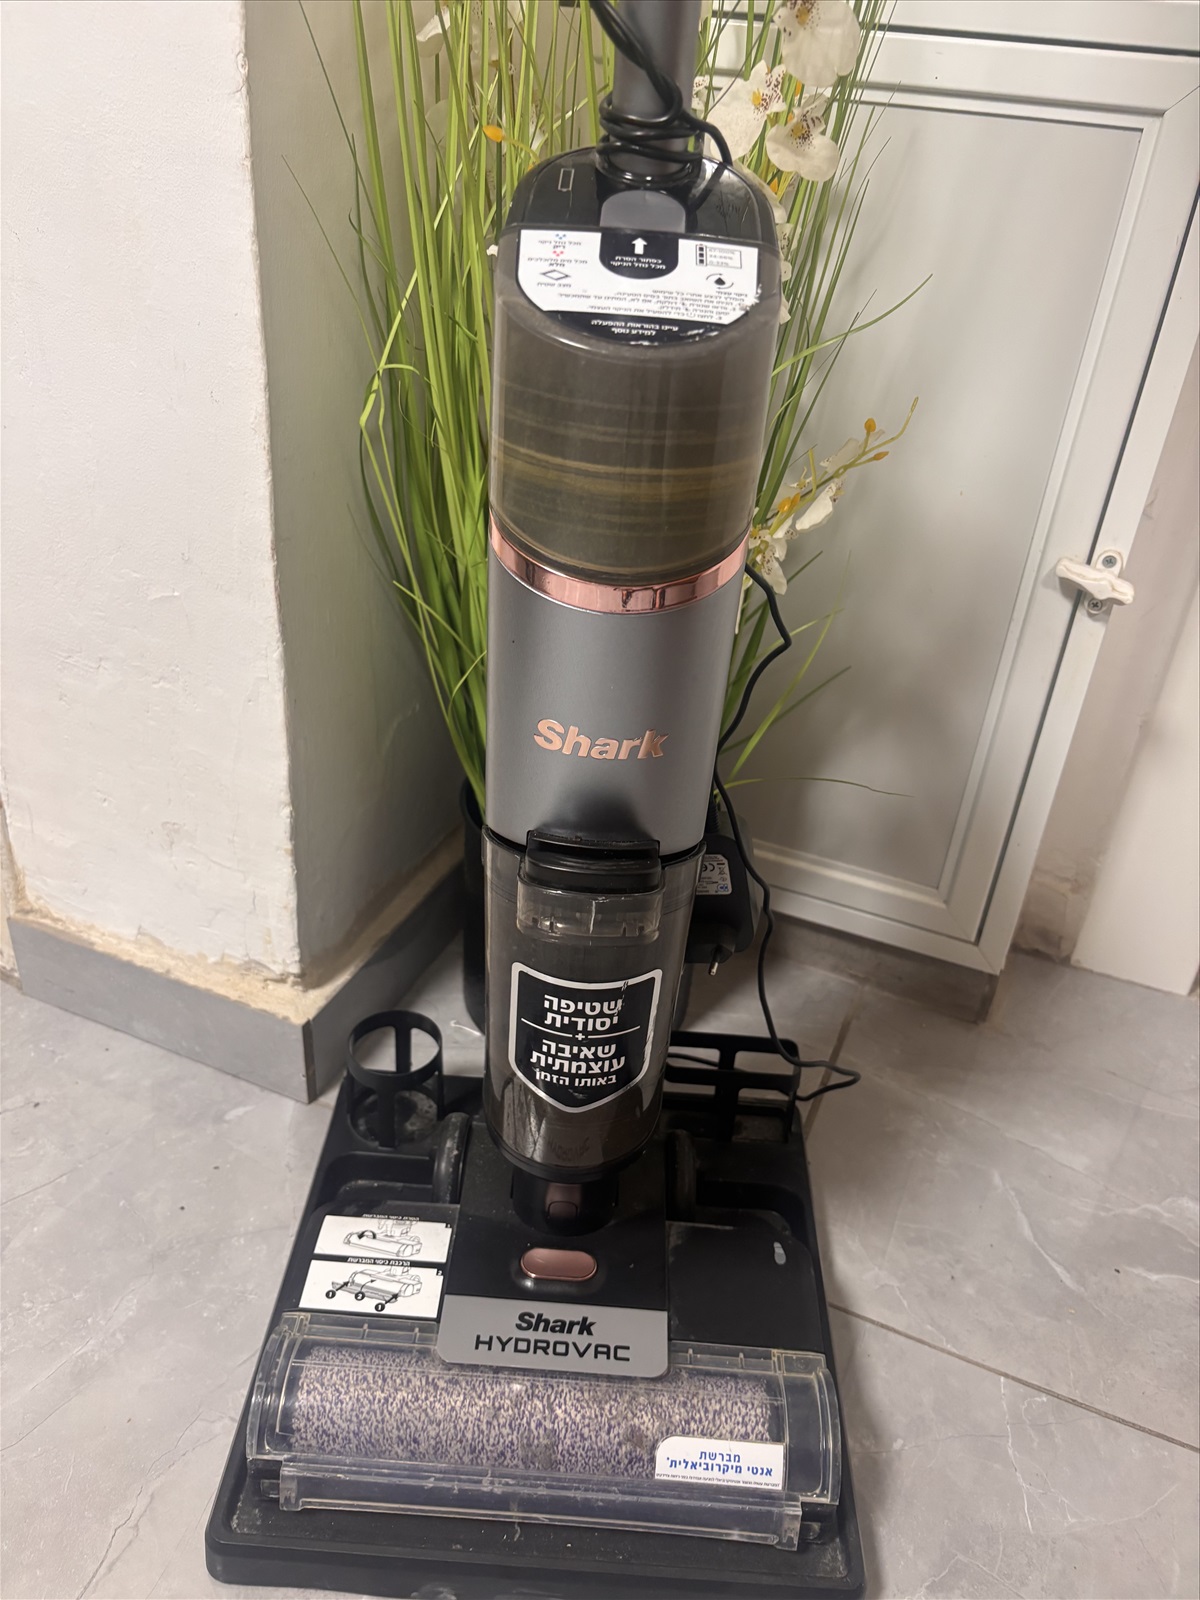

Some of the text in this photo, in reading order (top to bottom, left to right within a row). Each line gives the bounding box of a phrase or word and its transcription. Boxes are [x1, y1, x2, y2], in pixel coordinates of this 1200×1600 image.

[533, 718, 670, 760] Shark
[543, 994, 623, 1016] שטיפה
[544, 1011, 619, 1031] יסודית
[542, 1039, 616, 1059] שאיבה
[530, 1050, 626, 1074] עוצמתית
[536, 1068, 617, 1087] באותו הזמן
[515, 1311, 597, 1336] Shark
[474, 1334, 631, 1362] HYDROVAC
[699, 1450, 741, 1463] מברשת
[746, 1466, 773, 1477] אנטי
